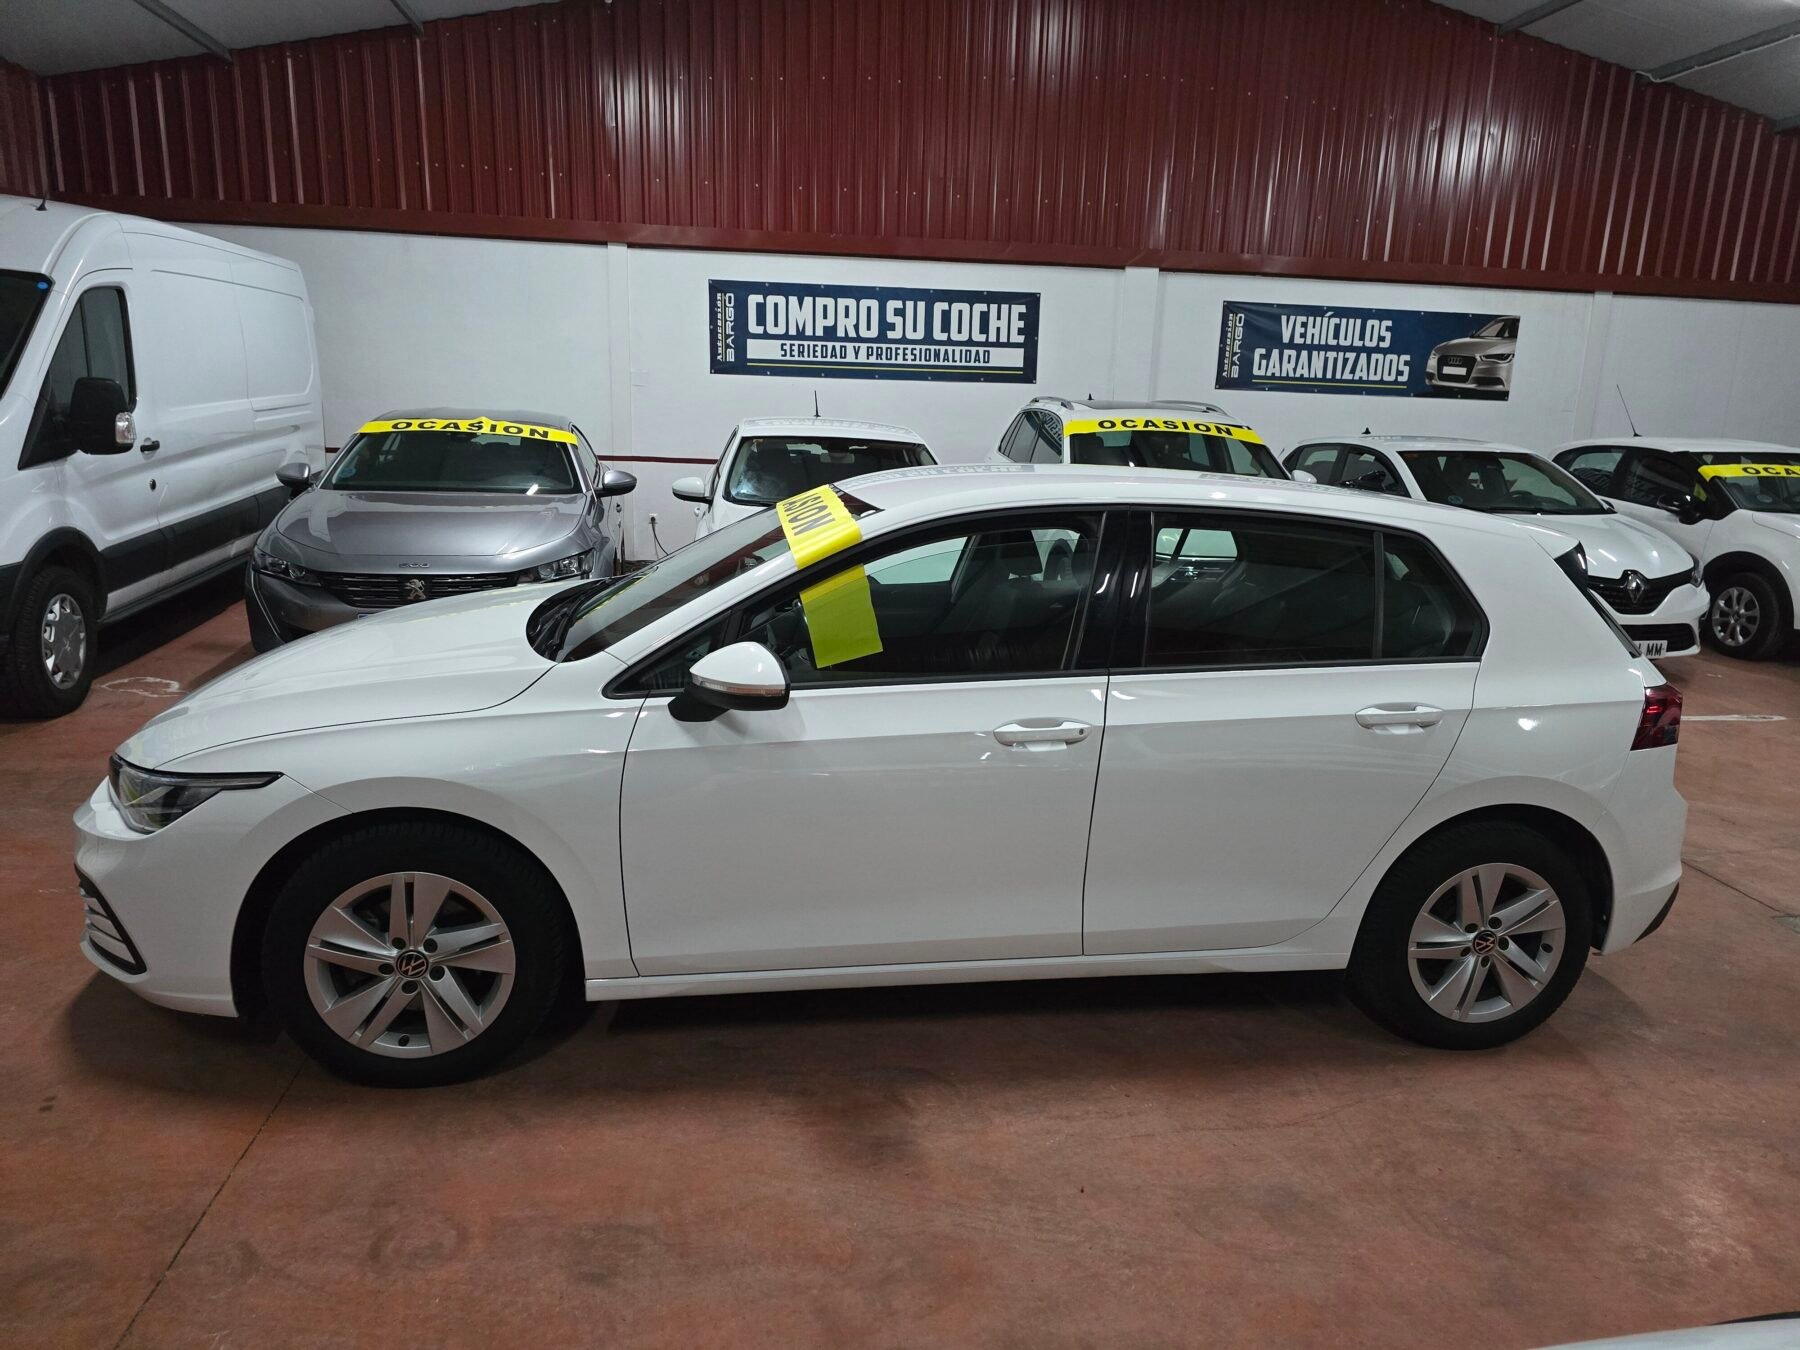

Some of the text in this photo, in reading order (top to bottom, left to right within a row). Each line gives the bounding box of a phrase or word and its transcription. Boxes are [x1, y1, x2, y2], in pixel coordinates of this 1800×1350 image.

[747, 293, 1027, 343] COMPRO SU COCHE
[1280, 311, 1393, 348] VEHÍCULOS
[780, 342, 991, 364] SERIEDAD Y PROFESIONALIDAD
[1252, 347, 1411, 382] GARANTIZADOS
[391, 420, 549, 439] OCASION
[1097, 418, 1234, 437] OCASION
